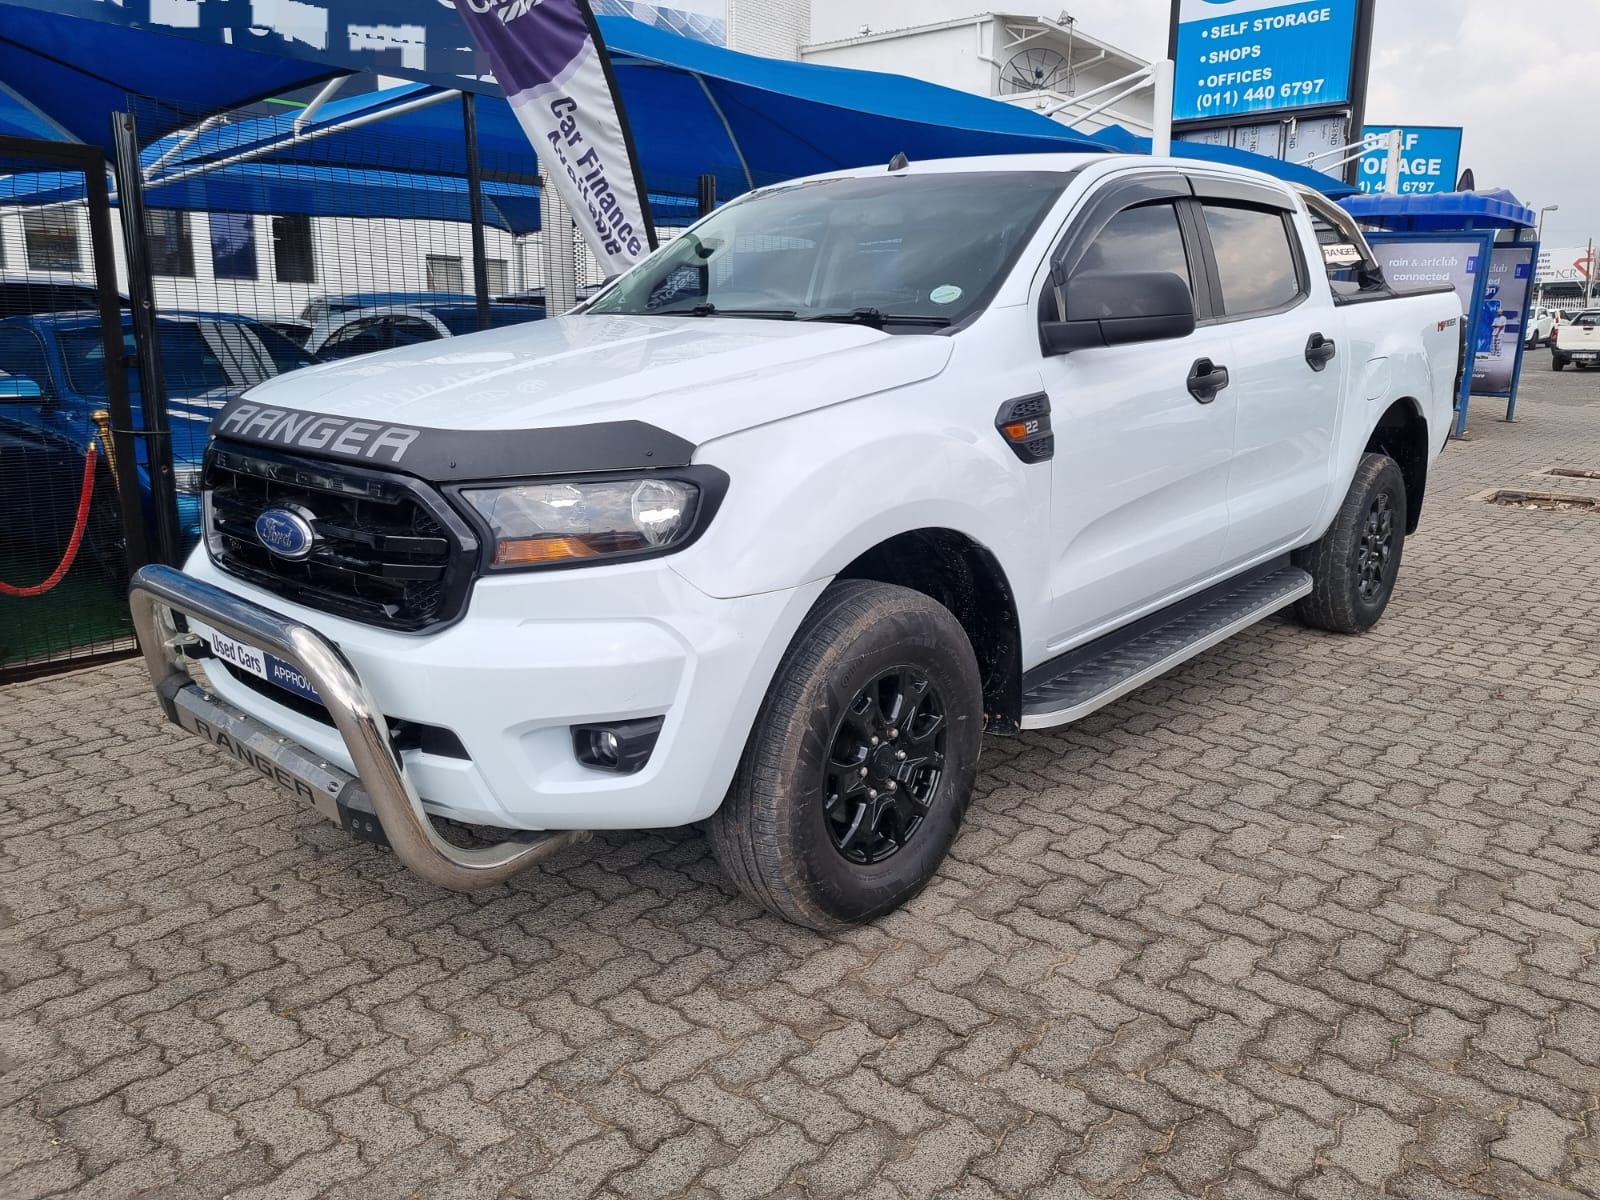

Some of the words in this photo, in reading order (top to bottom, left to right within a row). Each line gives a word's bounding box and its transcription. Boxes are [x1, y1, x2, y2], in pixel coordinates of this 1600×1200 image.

[1211, 21, 1248, 39] SELF
[1253, 8, 1331, 32] STORAGE
[1209, 45, 1261, 64] SHOPS
[1207, 67, 1272, 88] OFFICES
[1197, 90, 1238, 110] (011)
[1243, 85, 1275, 101] 440
[1280, 78, 1325, 97] 6797
[550, 96, 583, 147] Car
[576, 146, 641, 257] Finance
[1402, 181, 1435, 192] 6797
[1324, 246, 1360, 257] RANGER
[1388, 257, 1409, 267] rain
[1411, 258, 1419, 267] &
[1420, 256, 1458, 267] artclub
[1393, 272, 1450, 281] connected
[1555, 268, 1578, 279] NCR
[219, 404, 421, 463] RANGER
[262, 517, 293, 547] Ford
[211, 632, 237, 666] Used
[237, 646, 262, 674] Cars
[194, 717, 316, 805] RANGER
